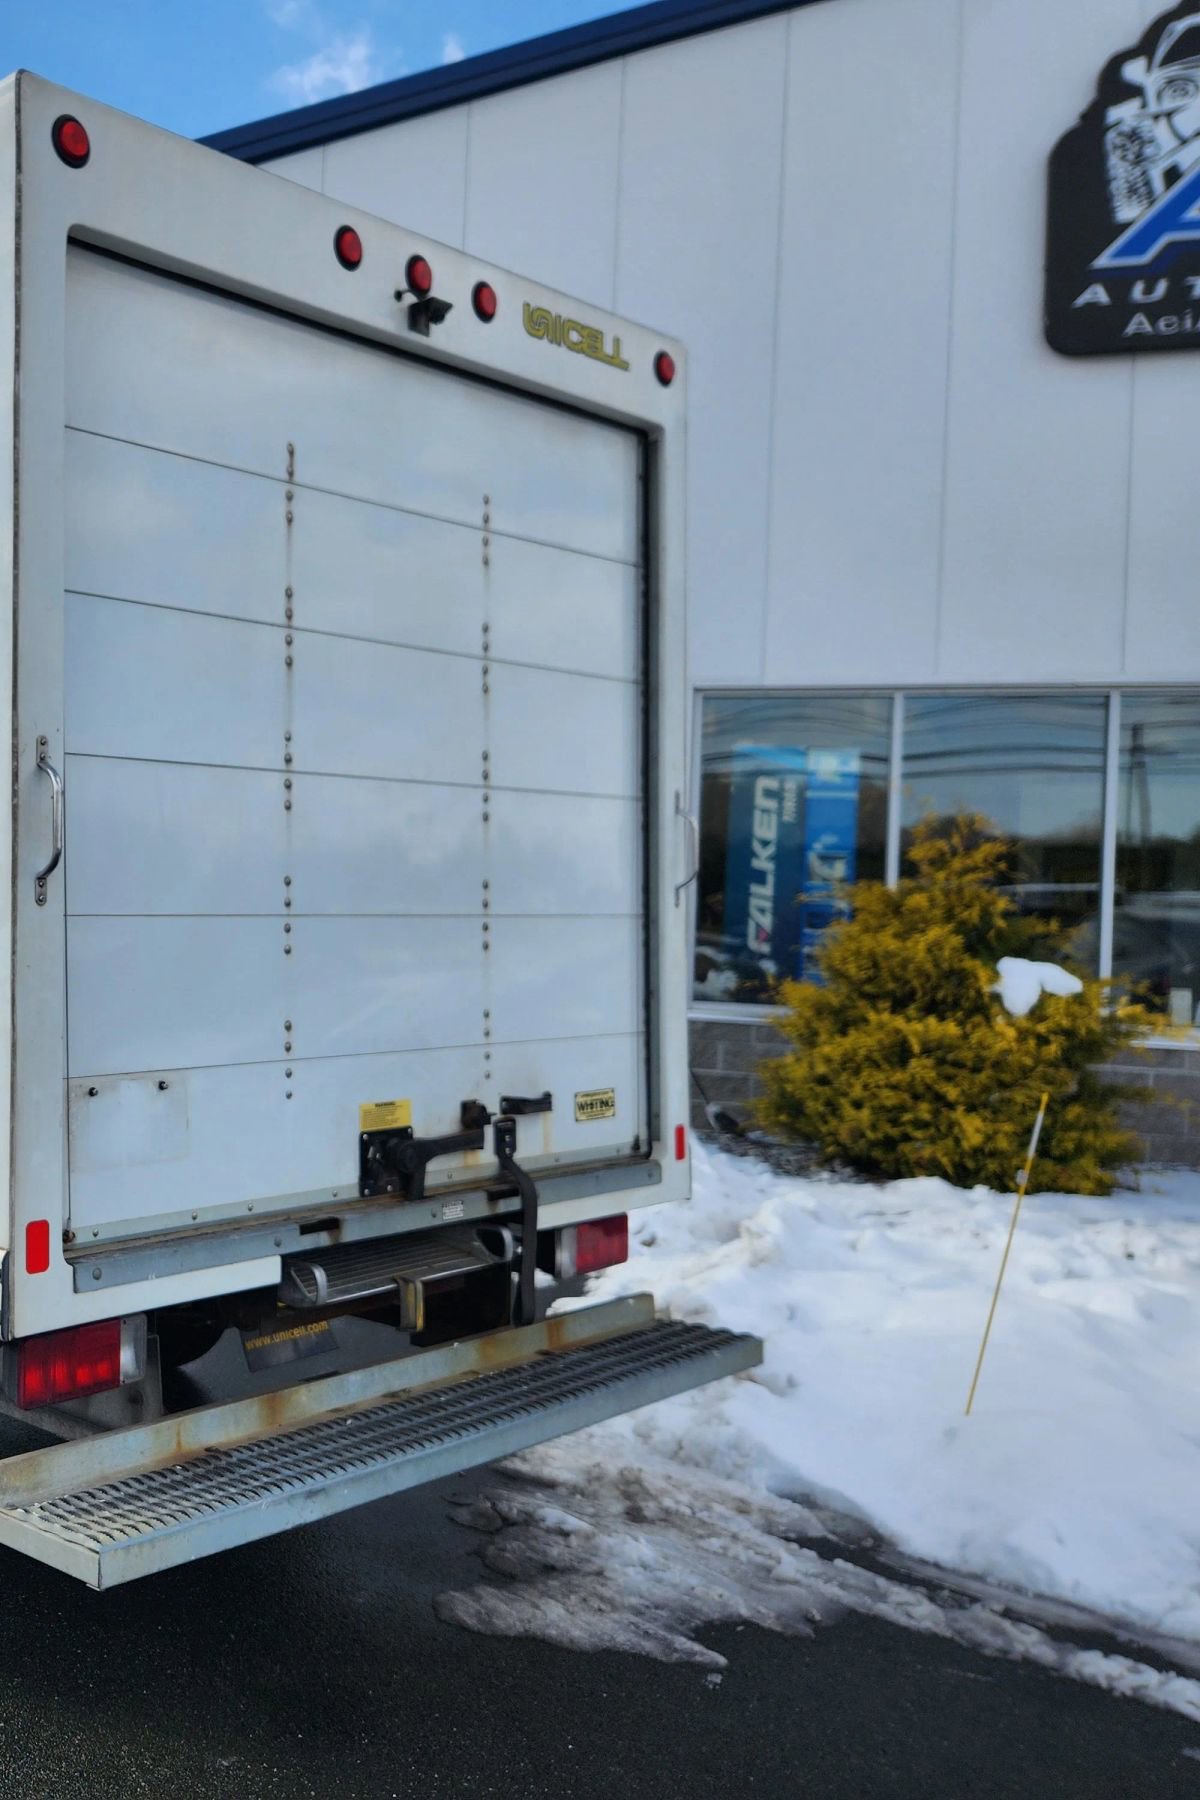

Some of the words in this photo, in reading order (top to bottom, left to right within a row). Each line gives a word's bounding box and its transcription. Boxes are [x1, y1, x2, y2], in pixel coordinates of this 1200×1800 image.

[522, 301, 630, 372] UNICELL
[746, 775, 780, 955] FALKEN
[244, 1321, 329, 1350] www.unicell.com
